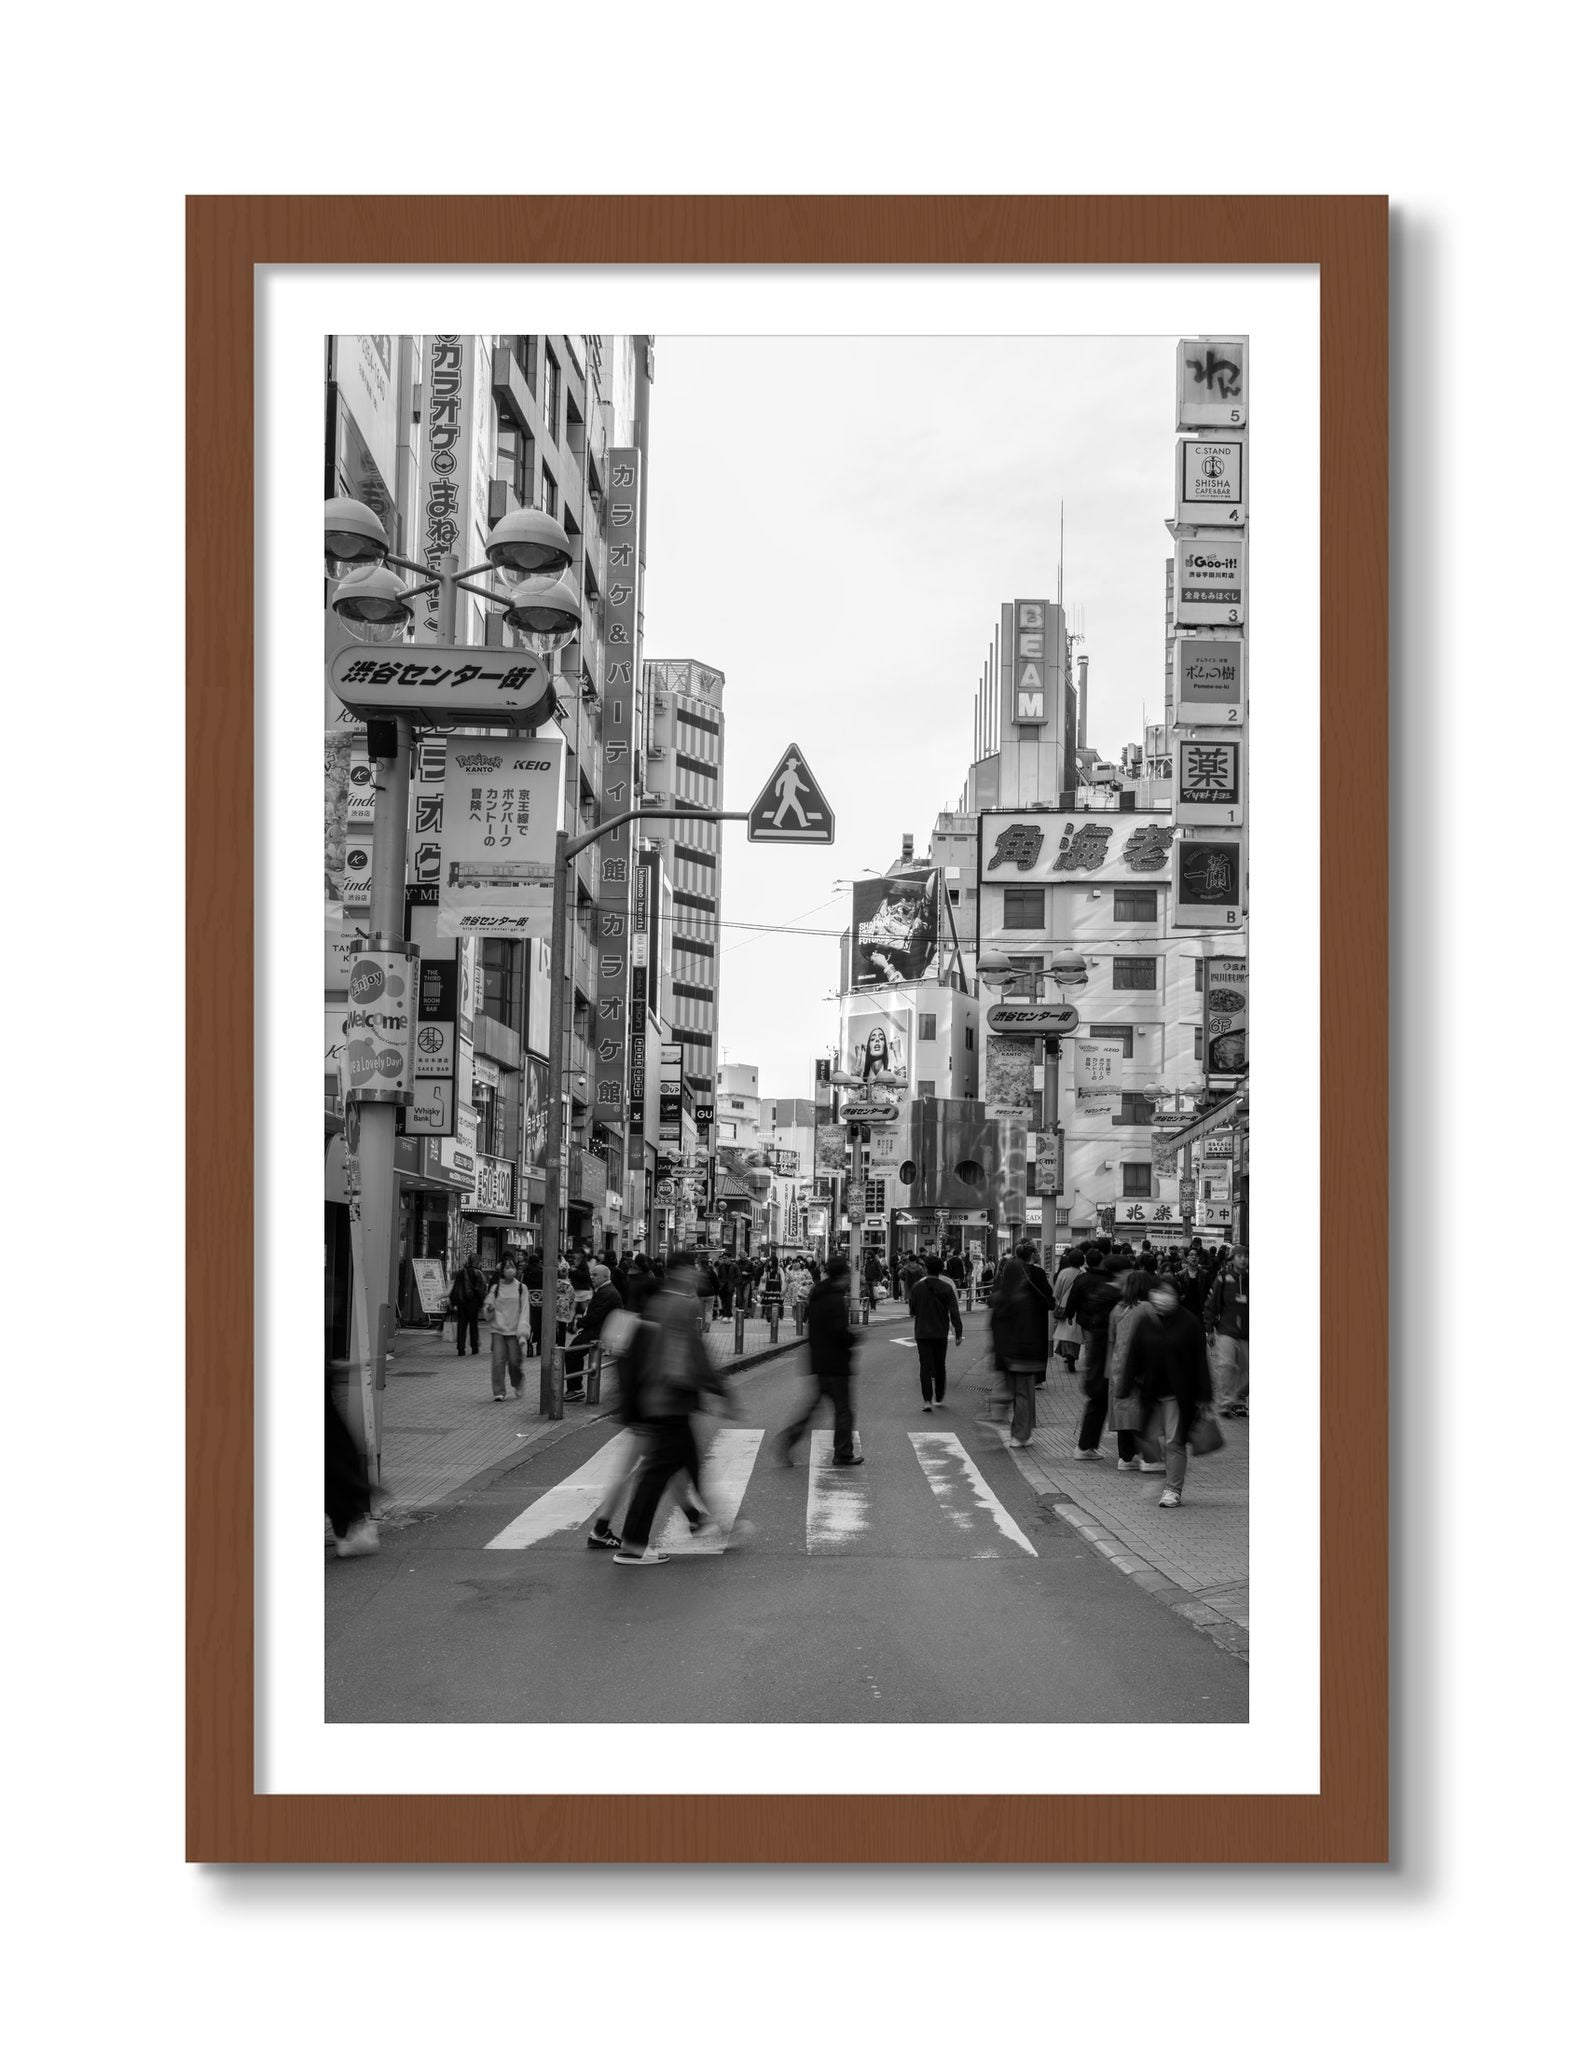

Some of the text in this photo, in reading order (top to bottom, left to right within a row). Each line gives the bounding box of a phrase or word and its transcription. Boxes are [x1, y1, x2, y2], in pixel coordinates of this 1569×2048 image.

[429, 344, 461, 450] カラオケ
[1231, 410, 1240, 422] 5
[1195, 447, 1231, 455] C.STAND
[1195, 479, 1231, 488] SHISHA
[1194, 556, 1237, 568] Goo-it!
[1185, 591, 1238, 601] 全身もみほぐし
[1229, 609, 1238, 622] 3
[1018, 603, 1044, 717] BEAM
[341, 660, 536, 690] 渋谷センター街
[1228, 709, 1237, 721] 2
[513, 760, 551, 771] KEIO
[1188, 747, 1228, 787] 薬
[469, 788, 482, 822] 冒険へ
[484, 788, 498, 847] カントーの
[517, 789, 530, 836] 京王線で
[1228, 810, 1234, 822] 1
[987, 823, 1174, 871] 角海老
[459, 916, 529, 927] 渋谷センター街
[1227, 911, 1236, 923] B
[352, 970, 383, 998] Enjoy
[597, 914, 625, 1105] カラオケ館
[992, 1011, 1074, 1021] 渋谷センター街
[1209, 1018, 1232, 1034] 6F
[361, 1056, 384, 1072] Lovely
[414, 1107, 440, 1116] Whisky
[697, 1110, 713, 1119] GU
[414, 1114, 430, 1122] Bank
[1126, 1204, 1173, 1221] 兆楽
